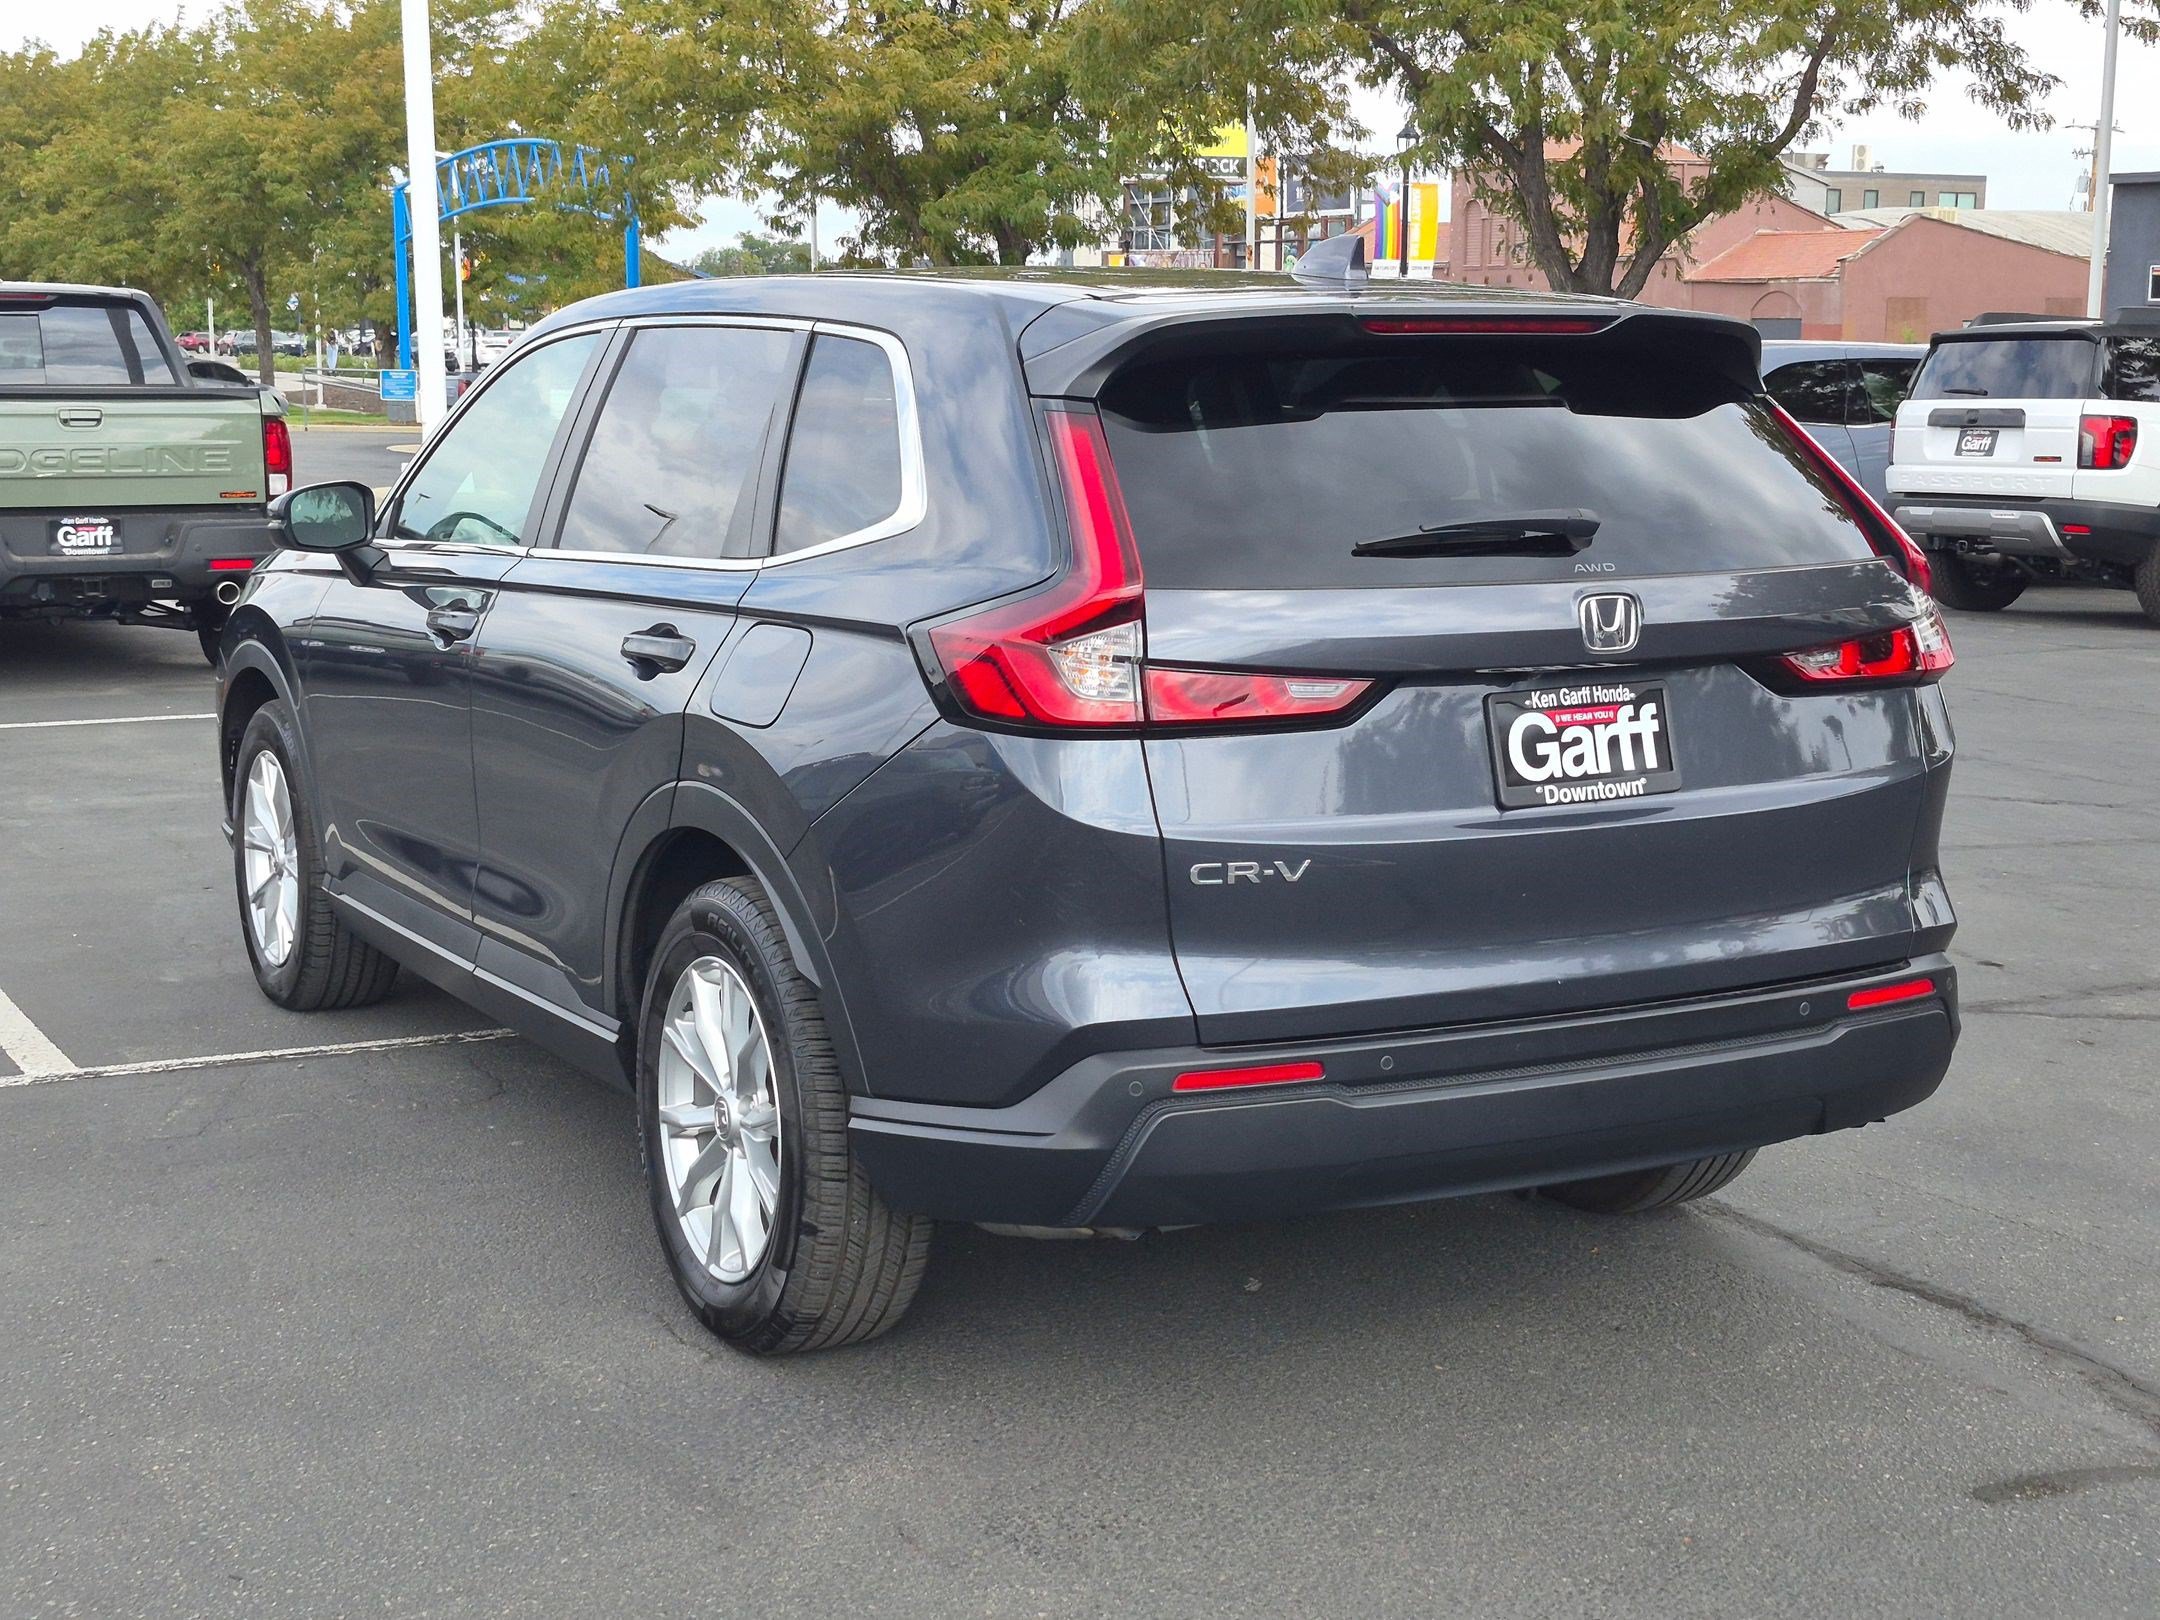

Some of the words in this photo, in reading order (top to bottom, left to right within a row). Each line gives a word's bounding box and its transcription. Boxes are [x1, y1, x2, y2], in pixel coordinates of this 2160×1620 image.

[57, 525, 114, 547] Garff
[1574, 563, 1616, 573] AWD
[1531, 691, 1558, 709] Ken
[1560, 686, 1591, 706] Garff
[1592, 684, 1631, 703] Honda
[1573, 712, 1592, 721] HEAR
[1593, 711, 1608, 719] YOU
[1508, 702, 1660, 782] Garff
[1544, 780, 1645, 805] Downtown
[1190, 859, 1311, 885] CR-V
